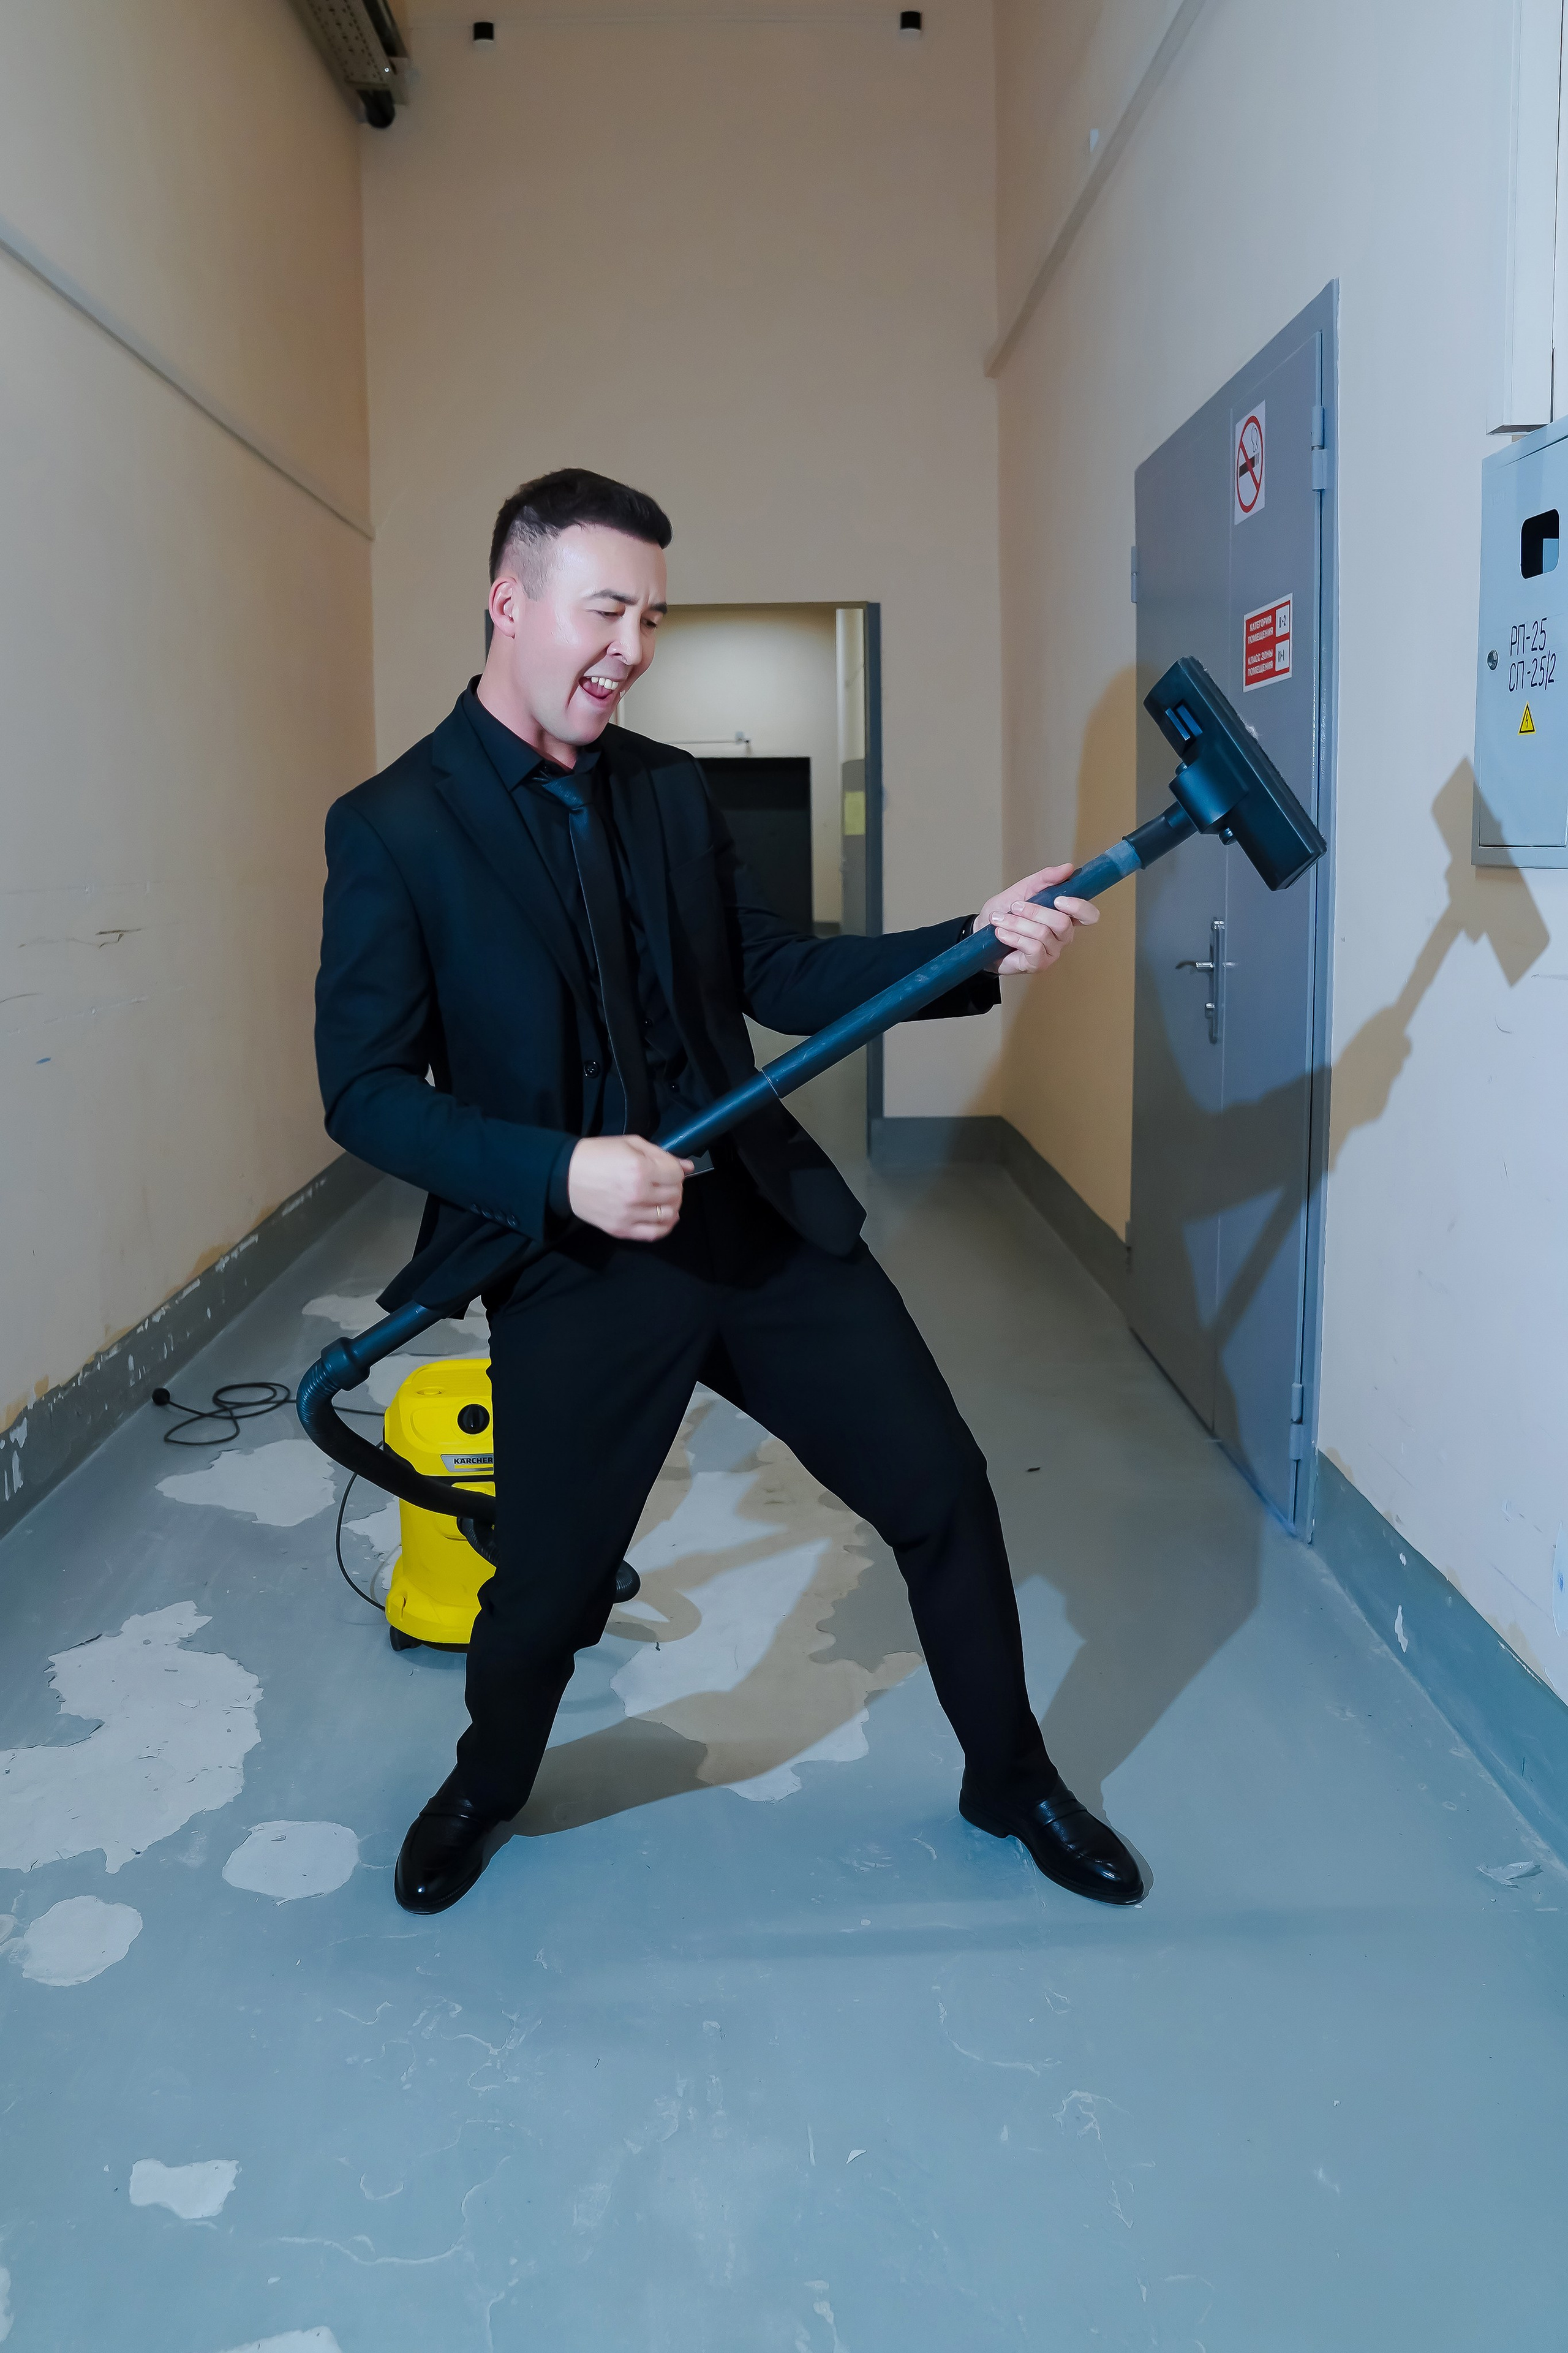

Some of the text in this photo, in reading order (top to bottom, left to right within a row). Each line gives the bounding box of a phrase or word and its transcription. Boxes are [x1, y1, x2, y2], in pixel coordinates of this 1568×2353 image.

[1250, 614, 1272, 632] КАТЕГОРИЯ
[1510, 617, 1548, 657] РП-25
[1509, 650, 1556, 692] СП-25/2
